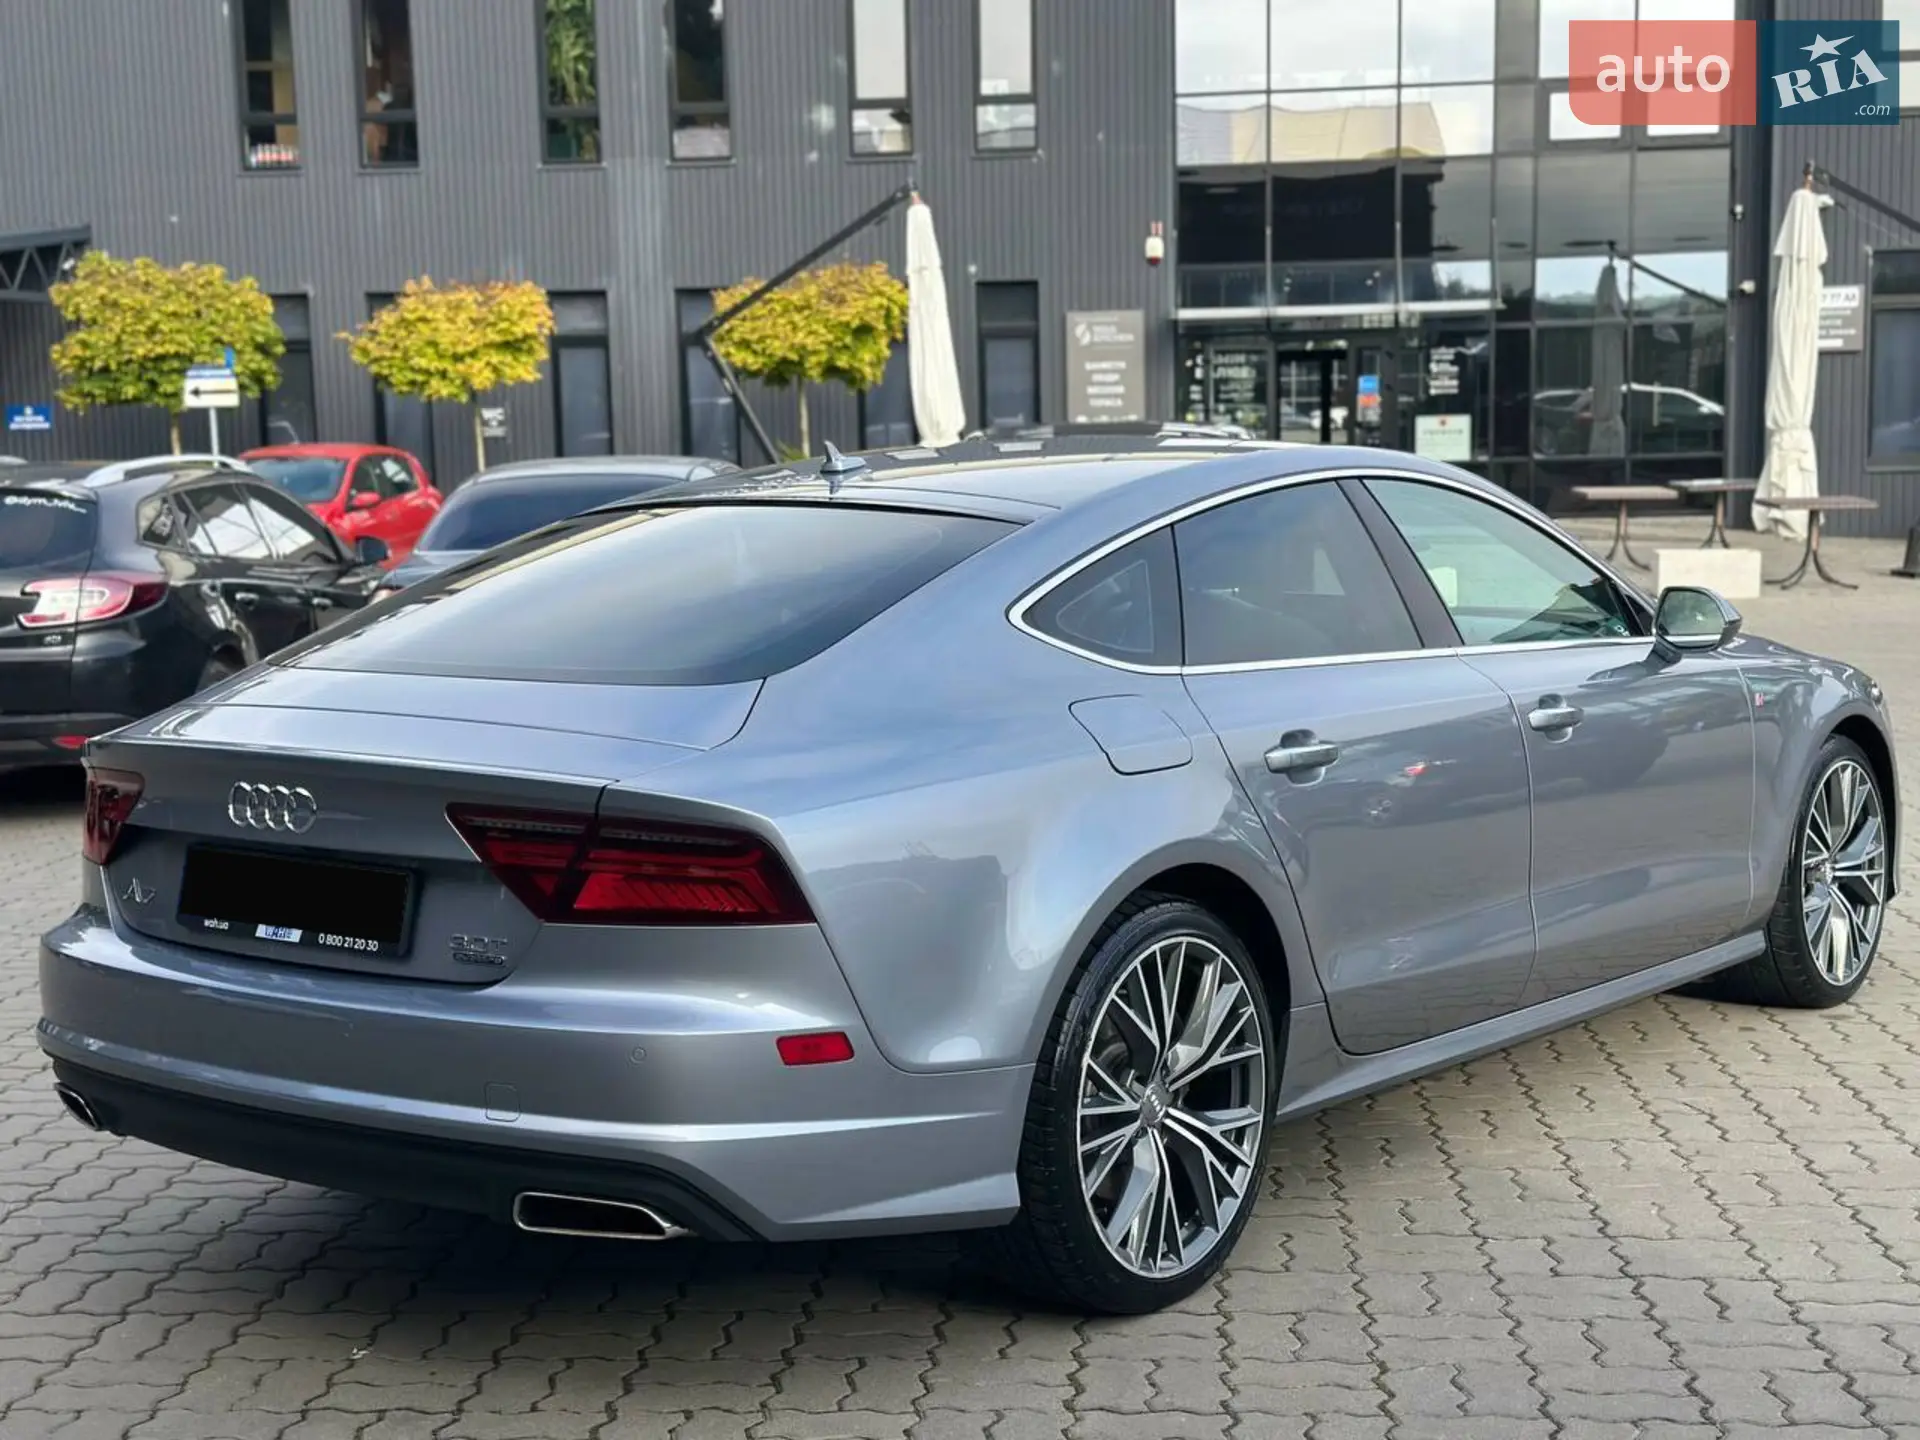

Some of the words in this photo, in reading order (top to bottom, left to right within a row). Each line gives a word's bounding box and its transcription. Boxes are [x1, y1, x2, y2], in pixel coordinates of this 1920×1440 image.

[121, 877, 157, 904] A7
[317, 932, 325, 944] 0
[325, 933, 344, 947] 800
[343, 936, 354, 949] 21
[354, 938, 366, 951] 20
[366, 939, 379, 952] 30
